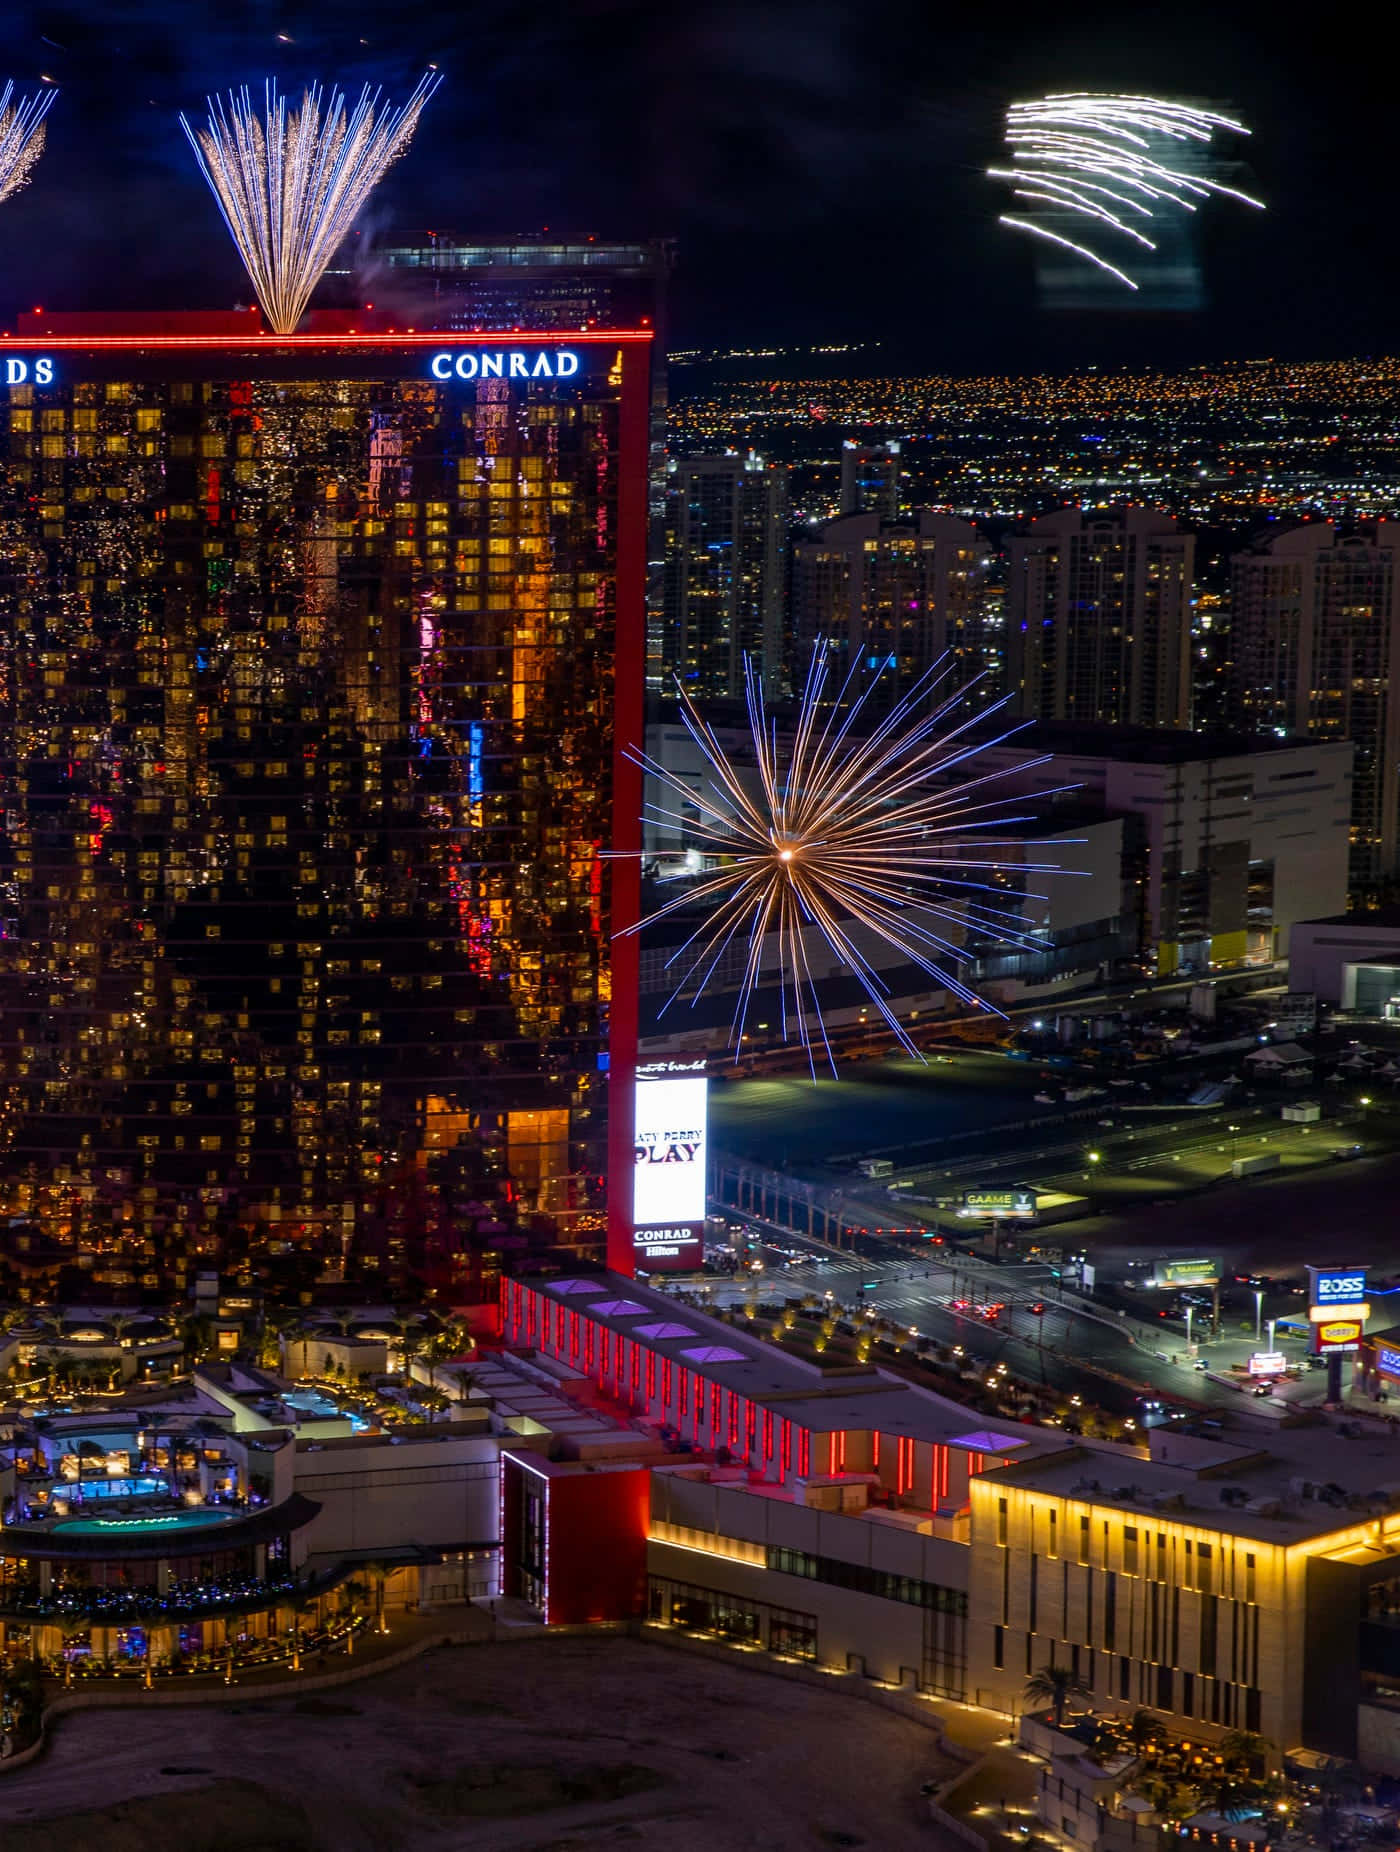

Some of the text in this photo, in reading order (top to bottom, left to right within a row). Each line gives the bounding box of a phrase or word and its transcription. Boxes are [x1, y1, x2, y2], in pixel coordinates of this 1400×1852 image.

[431, 351, 579, 379] CONRAD
[633, 1142, 702, 1164] PLAY
[634, 1228, 692, 1242] CONRAD
[1319, 1277, 1365, 1294] ROSS
